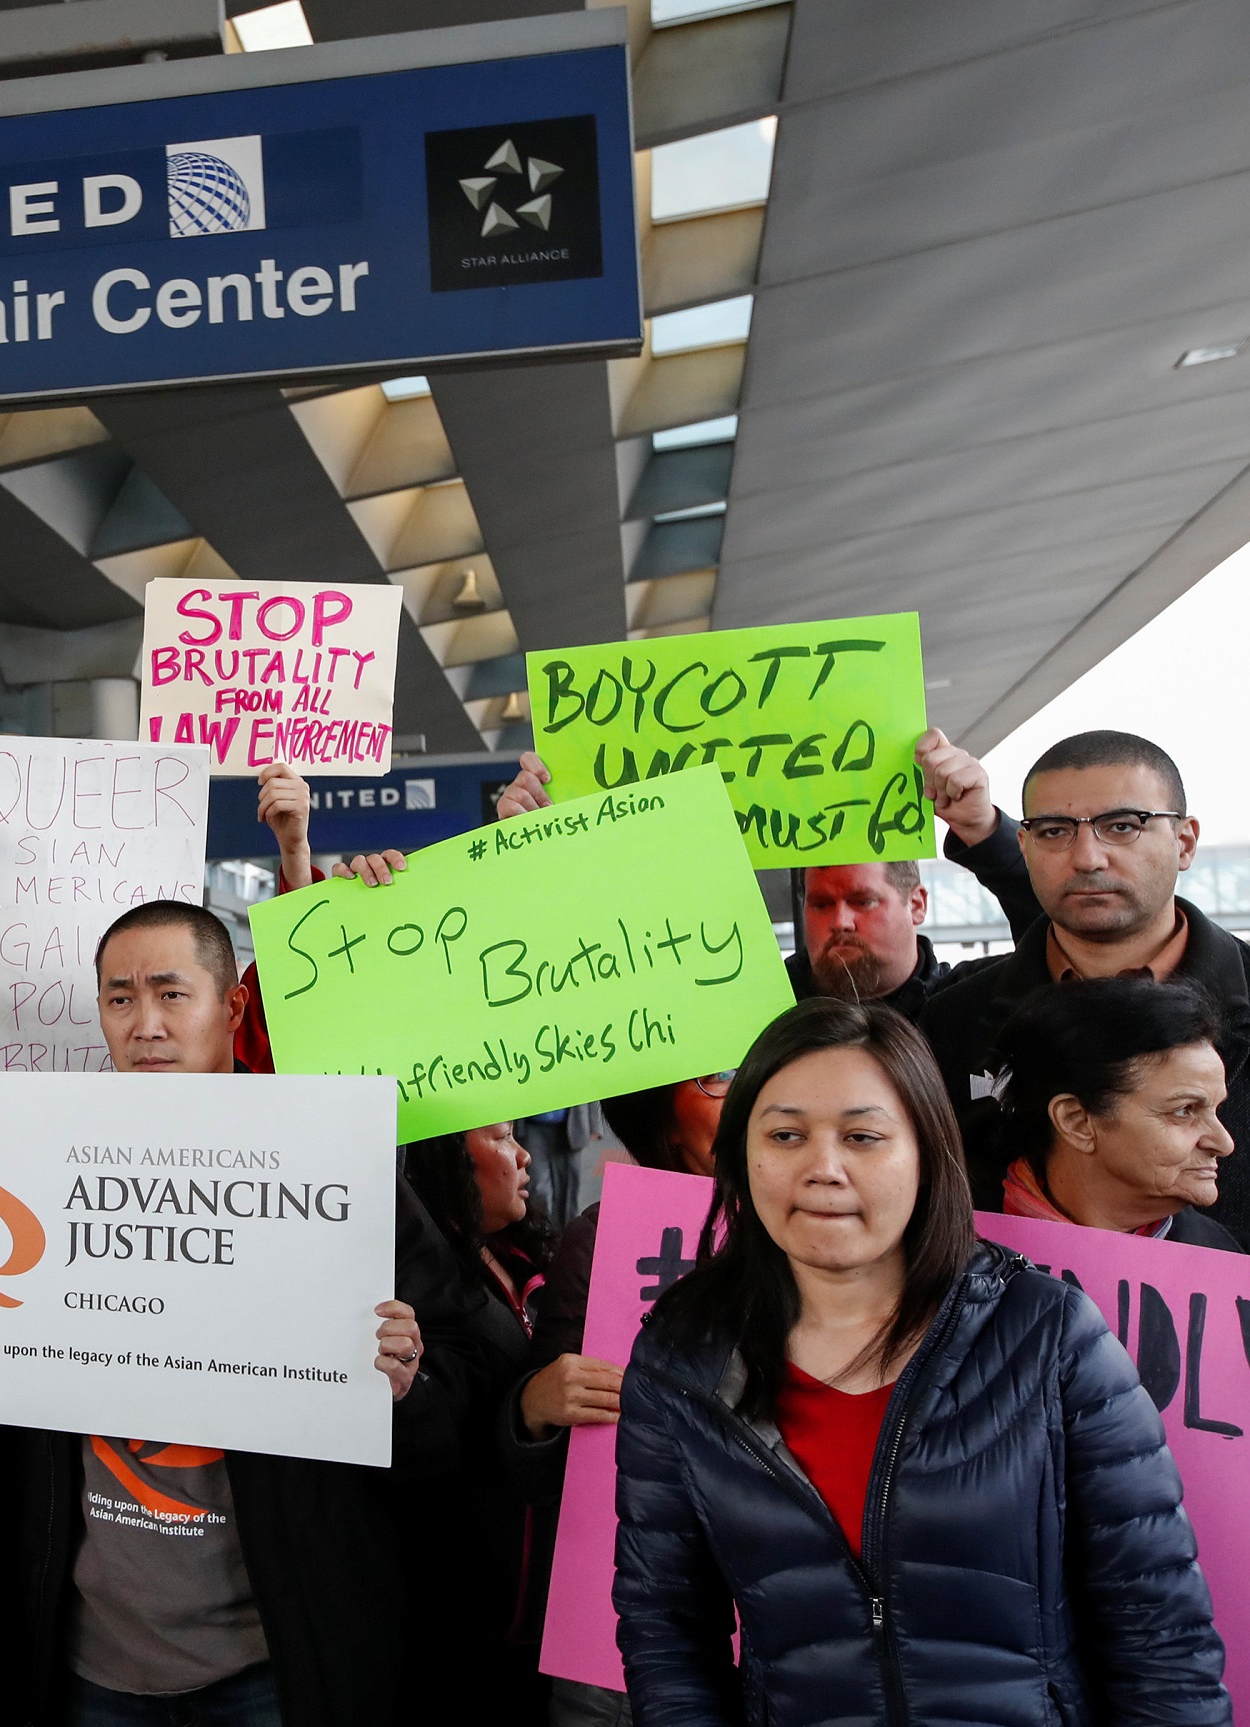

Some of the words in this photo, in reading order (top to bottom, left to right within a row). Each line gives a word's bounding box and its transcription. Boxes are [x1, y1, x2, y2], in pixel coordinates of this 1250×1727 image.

[461, 255, 497, 268] STAR
[501, 249, 570, 264] ALLIANCE
[92, 258, 369, 336] Center
[176, 589, 354, 647] STOP
[151, 647, 376, 690] BRUTALITY
[541, 639, 886, 734] BOYCOTT
[215, 688, 283, 715] FROM
[292, 684, 332, 716] ALL
[247, 716, 393, 768] ENFORCEMENT
[594, 719, 876, 790] UNITED
[596, 793, 665, 826] Asian
[480, 918, 744, 1007] Brutality
[629, 1008, 676, 1052] Chi
[65, 1145, 133, 1165] ASIAN
[140, 1147, 280, 1170] AMERICANS
[63, 1175, 352, 1222] ADVANCING
[65, 1221, 235, 1267] JUSTICE
[63, 1291, 165, 1315] CHICAGO
[3, 1344, 38, 1361] upon
[42, 1345, 64, 1360] the
[68, 1347, 113, 1368] legacy
[117, 1351, 132, 1366] of
[136, 1352, 160, 1368] the
[163, 1355, 203, 1372] Asian
[207, 1358, 278, 1379] American
[283, 1364, 349, 1385] Institute
[89, 1507, 114, 1521] Asian
[115, 1513, 159, 1532] American
[159, 1524, 205, 1536] Institute
[114, 1499, 139, 1513] upon
[140, 1505, 153, 1518] the
[154, 1509, 190, 1525] Legacy
[193, 1511, 205, 1523] of
[207, 1513, 226, 1524] the
